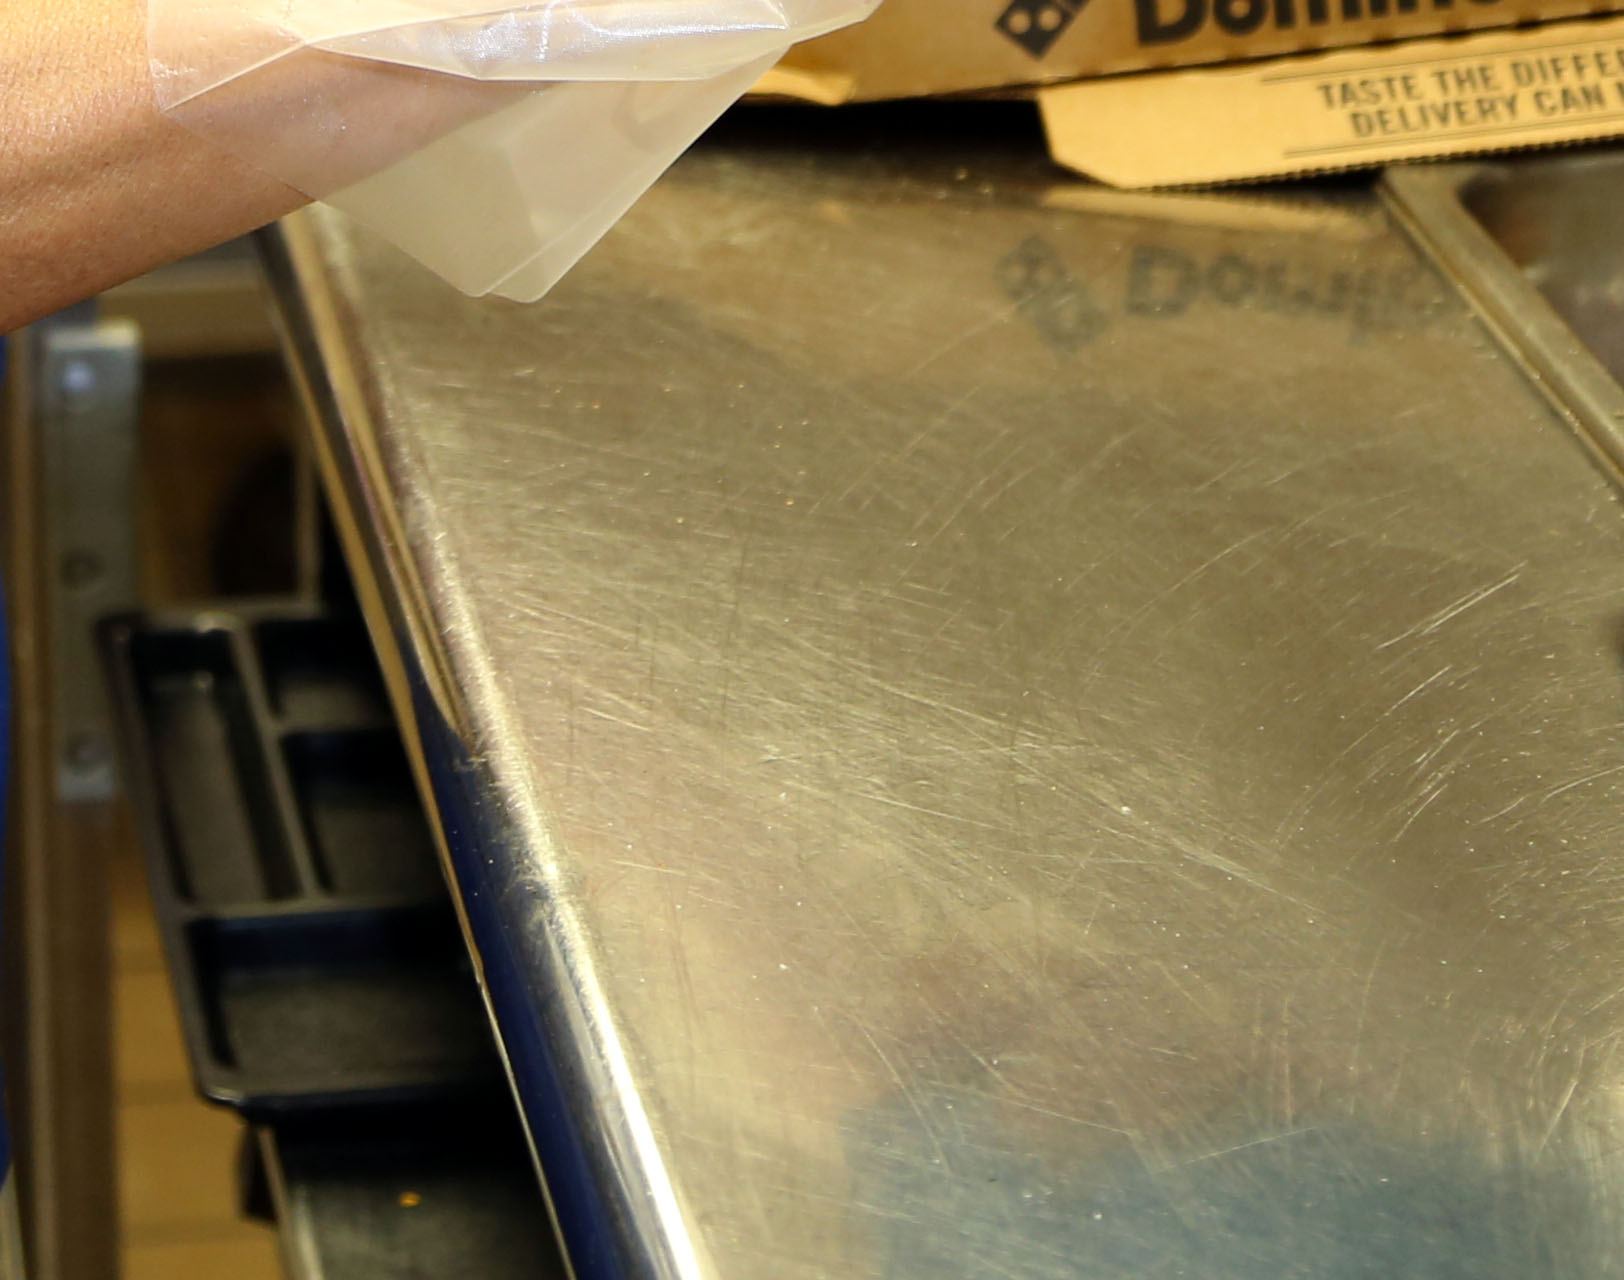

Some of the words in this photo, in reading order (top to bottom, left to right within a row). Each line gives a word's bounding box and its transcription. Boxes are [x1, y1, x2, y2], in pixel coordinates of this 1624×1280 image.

[1317, 74, 1424, 111] TASTE
[1431, 65, 1503, 99] THE
[1349, 93, 1522, 139] DELIVERY
[1532, 83, 1607, 118] CAN
